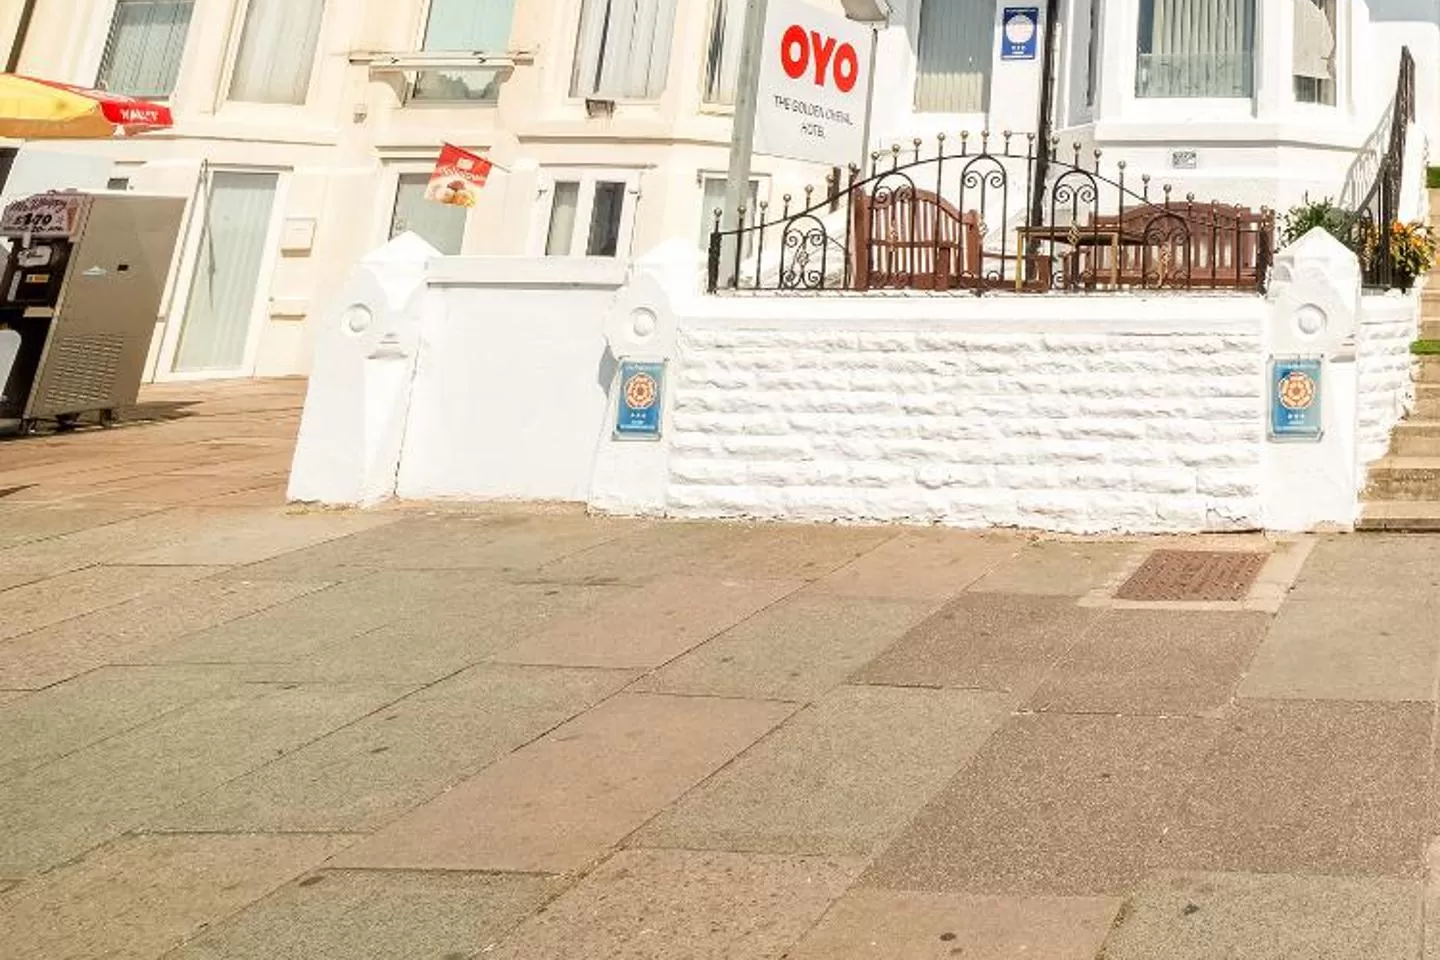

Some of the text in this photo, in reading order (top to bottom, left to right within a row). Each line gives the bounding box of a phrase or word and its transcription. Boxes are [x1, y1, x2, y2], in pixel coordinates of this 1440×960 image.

[780, 24, 859, 93] OYO
[774, 95, 790, 110] THE
[792, 99, 824, 119] GOLDEN
